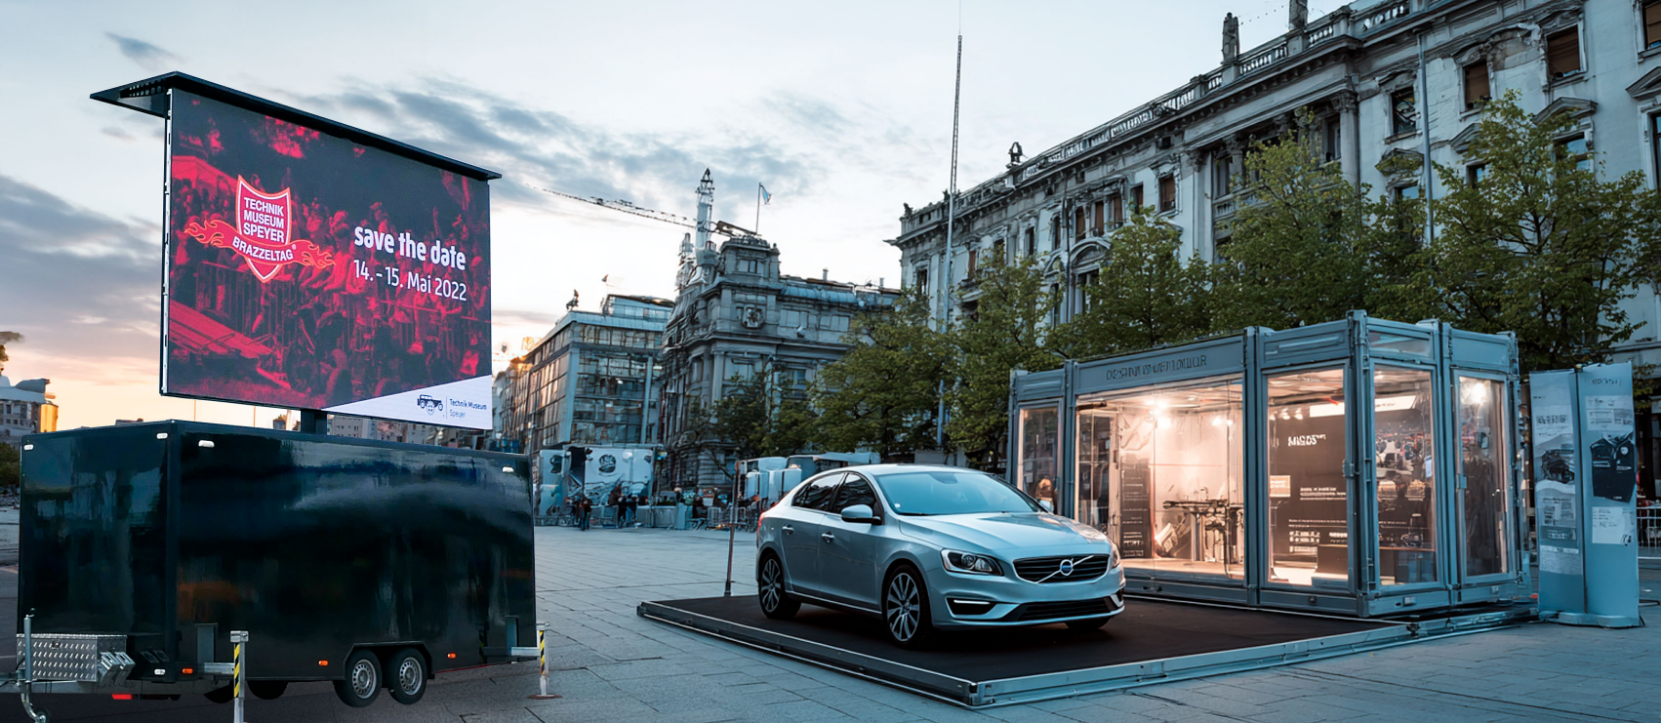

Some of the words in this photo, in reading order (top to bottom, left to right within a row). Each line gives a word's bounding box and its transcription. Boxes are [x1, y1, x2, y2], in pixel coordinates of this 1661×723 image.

[243, 197, 284, 217] TECHNIK
[243, 209, 285, 229] MUSEUM
[243, 221, 285, 243] SPEYER
[354, 226, 395, 253] save
[398, 232, 427, 261] the
[430, 240, 466, 271] date
[407, 271, 431, 294] Mai
[434, 277, 467, 301] 2022
[449, 398, 468, 407] Technik
[467, 401, 488, 410] Museum
